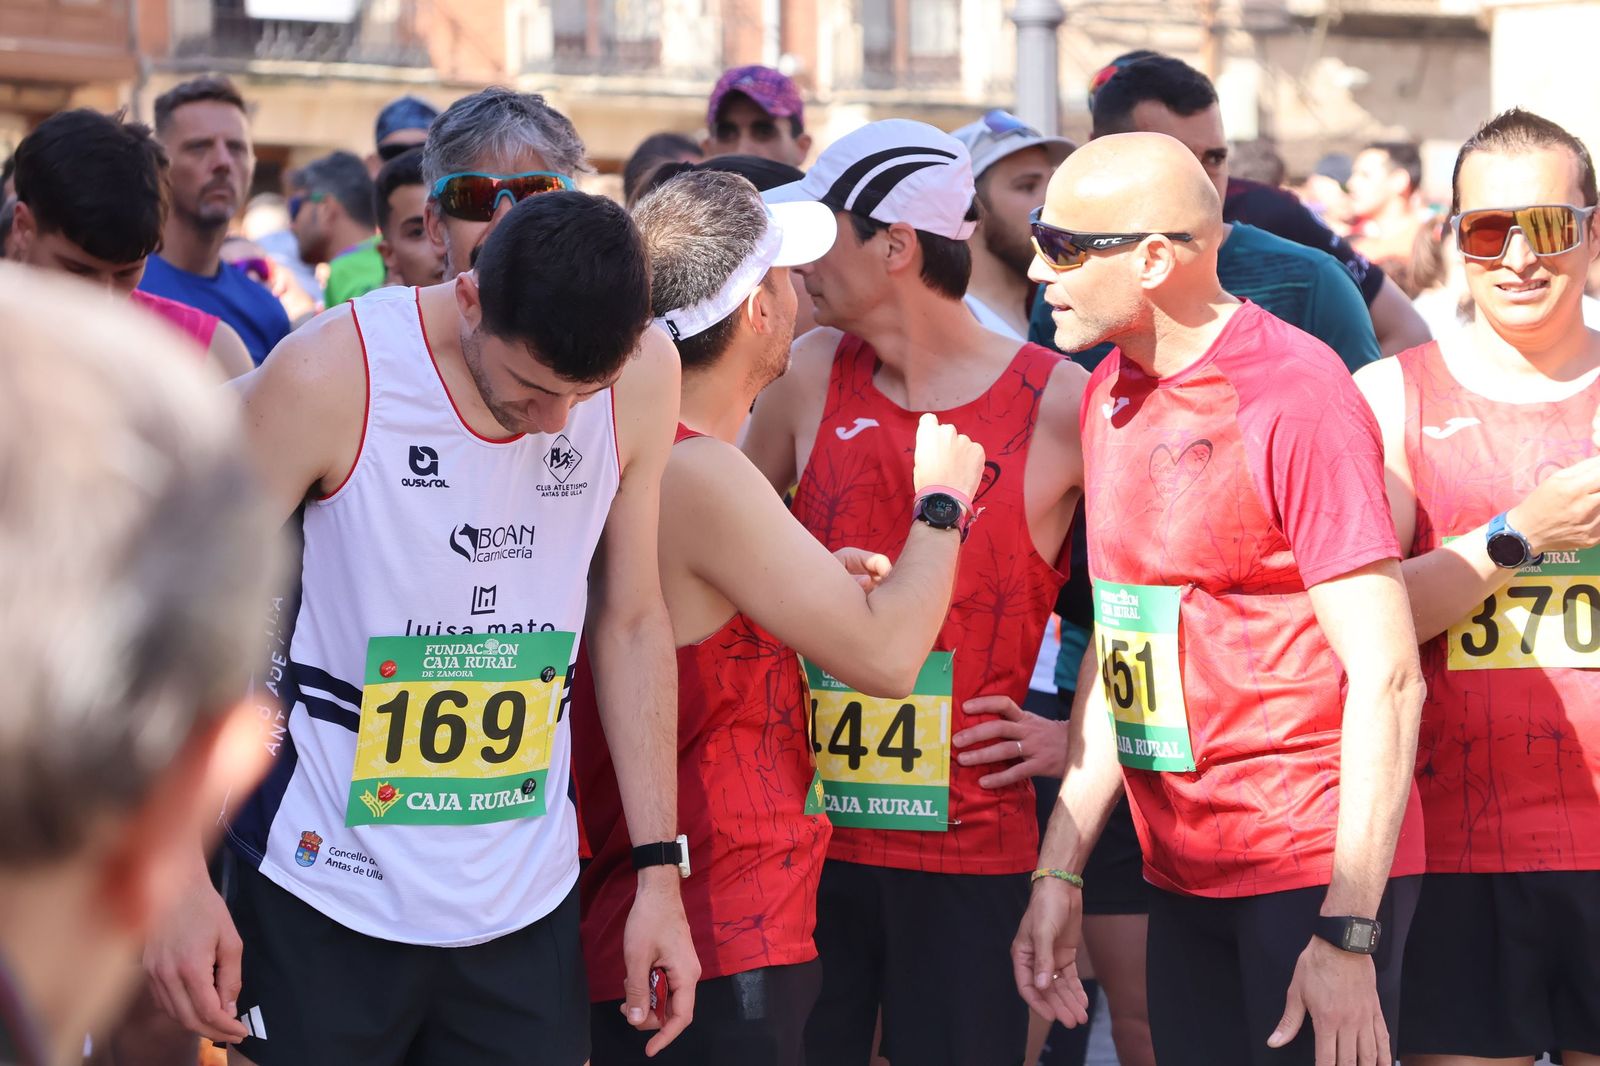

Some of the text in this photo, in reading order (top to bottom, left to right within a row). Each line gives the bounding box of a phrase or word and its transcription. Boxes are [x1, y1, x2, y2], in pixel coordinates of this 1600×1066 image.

[554, 482, 588, 490] ATLETISMO
[478, 524, 535, 549] BOAN
[476, 546, 533, 562] carnicería
[1542, 551, 1580, 564] URAL
[405, 619, 555, 637] luisa mato
[1461, 584, 1600, 656] 370
[423, 656, 517, 669] CAJA RURAL
[436, 670, 474, 678] ZAMORA
[376, 690, 526, 764] 169
[1117, 735, 1184, 759] AJA RURAL
[406, 792, 463, 811] CAJA
[868, 797, 938, 816] RURAL
[329, 847, 368, 862] Concello
[325, 857, 383, 881] Antas de Ulla
